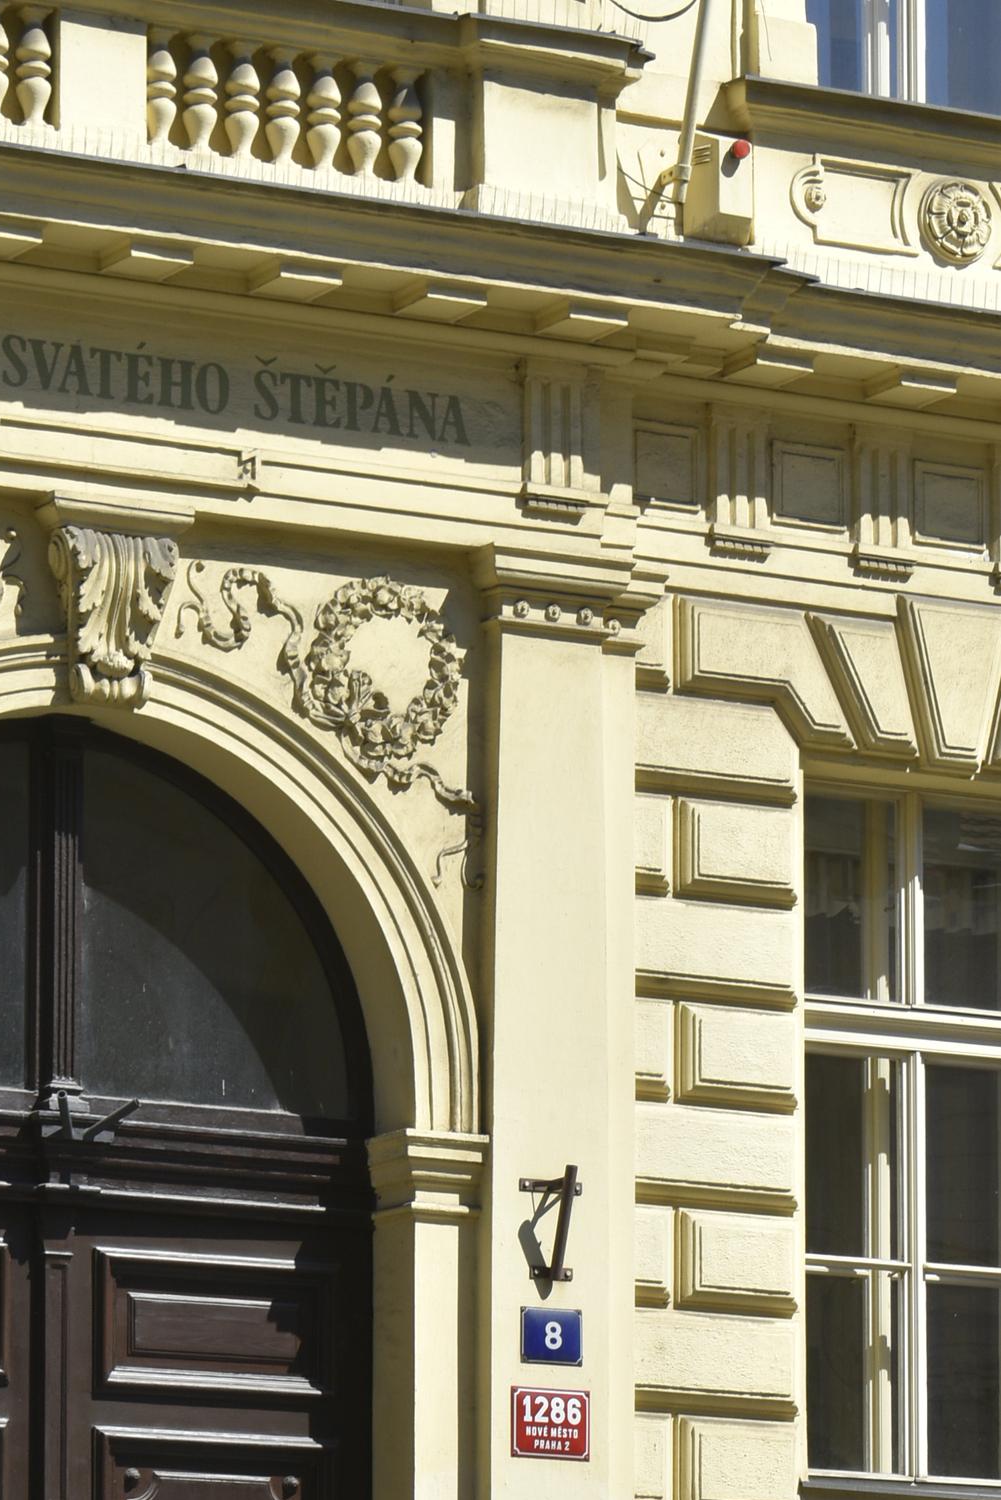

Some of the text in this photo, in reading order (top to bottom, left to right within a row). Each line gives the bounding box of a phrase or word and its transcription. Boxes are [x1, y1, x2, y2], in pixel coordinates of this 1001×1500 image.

[1, 334, 230, 415] SVATÉHO
[253, 355, 472, 447] ŠTĚPÁNA
[544, 1321, 563, 1350] 8
[523, 1395, 582, 1425] 1286
[525, 1425, 548, 1437] NOVÉ
[533, 1439, 570, 1451] PRAHA 2
